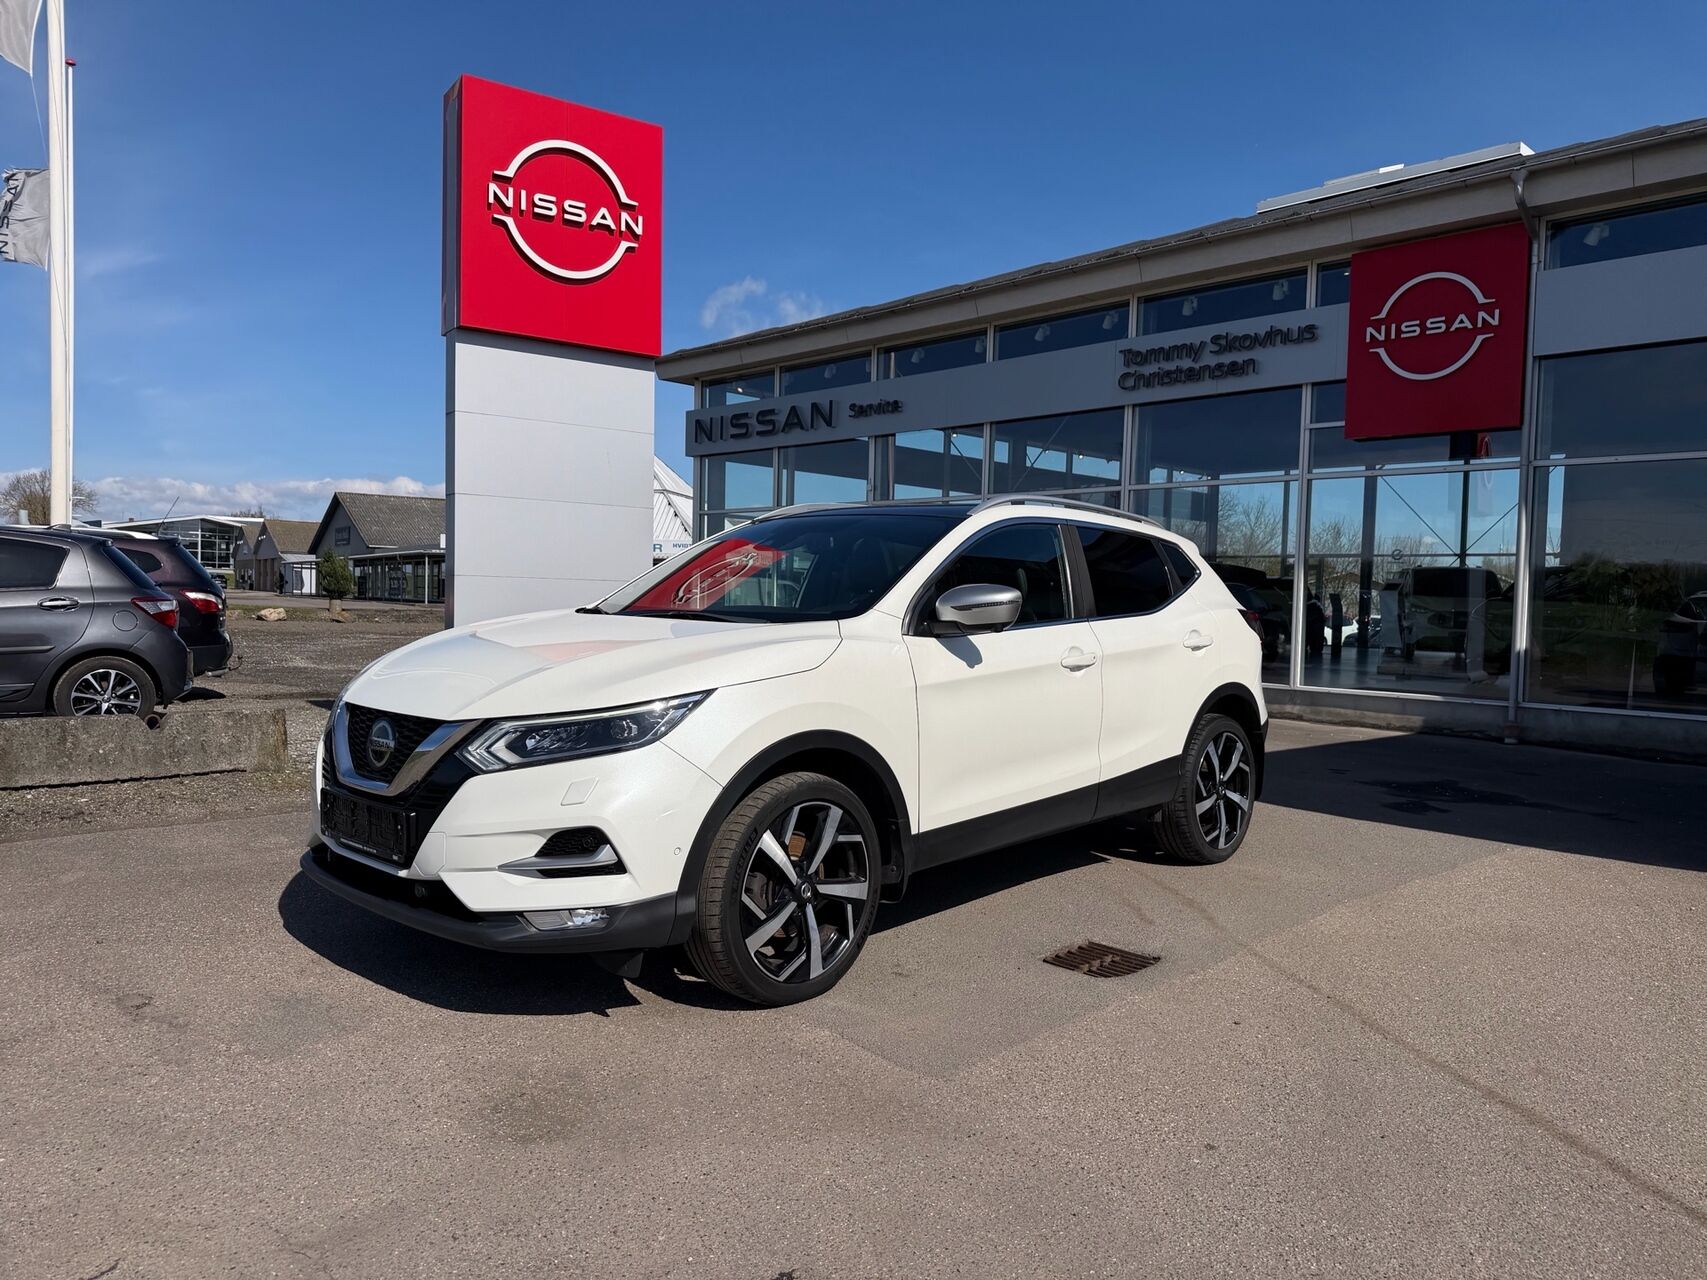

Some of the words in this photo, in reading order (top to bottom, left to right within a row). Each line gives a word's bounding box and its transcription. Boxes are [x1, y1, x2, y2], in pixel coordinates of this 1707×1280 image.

[488, 182, 643, 237] NISSAN
[1119, 340, 1206, 369] Tommy
[1209, 324, 1319, 355] Skovhus
[1365, 308, 1500, 343] NISSAN
[1118, 358, 1259, 392] Christensen
[694, 400, 834, 443] NISSAN
[848, 399, 903, 418] Service
